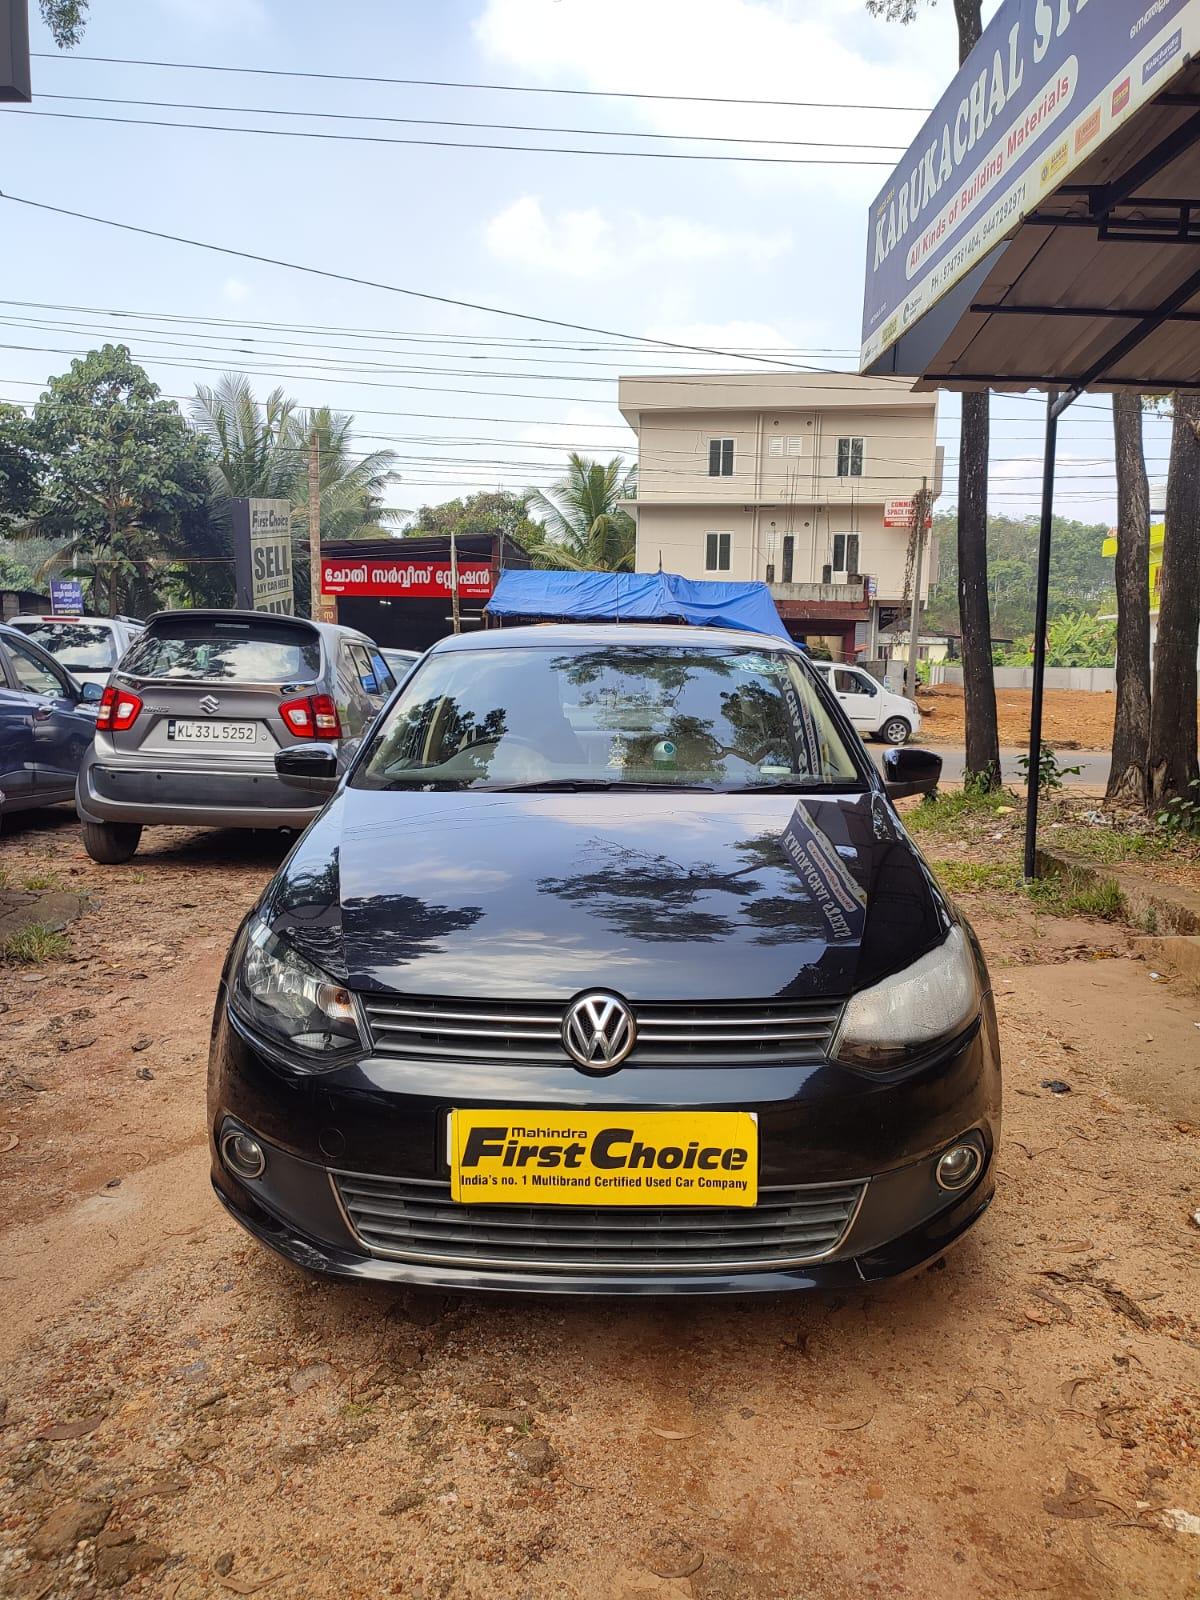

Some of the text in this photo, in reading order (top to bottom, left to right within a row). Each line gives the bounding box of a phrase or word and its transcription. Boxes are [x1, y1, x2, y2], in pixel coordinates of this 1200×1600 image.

[873, 21, 1024, 273] KARUKACHAL
[909, 243, 920, 268] All
[922, 218, 946, 254] Kinds
[949, 200, 958, 224] of
[961, 151, 1003, 212] Building
[1007, 76, 1069, 159] Materials
[254, 545, 290, 581] SELL
[324, 565, 368, 583] ചോതി
[267, 580, 278, 592] CAR
[177, 725, 254, 740] KL 33 L 5252
[511, 1127, 588, 1139] Mahindra
[461, 1127, 748, 1171] First Choice
[461, 1175, 748, 1191] India's no. 1 Multibrand Certified Used Car Company
